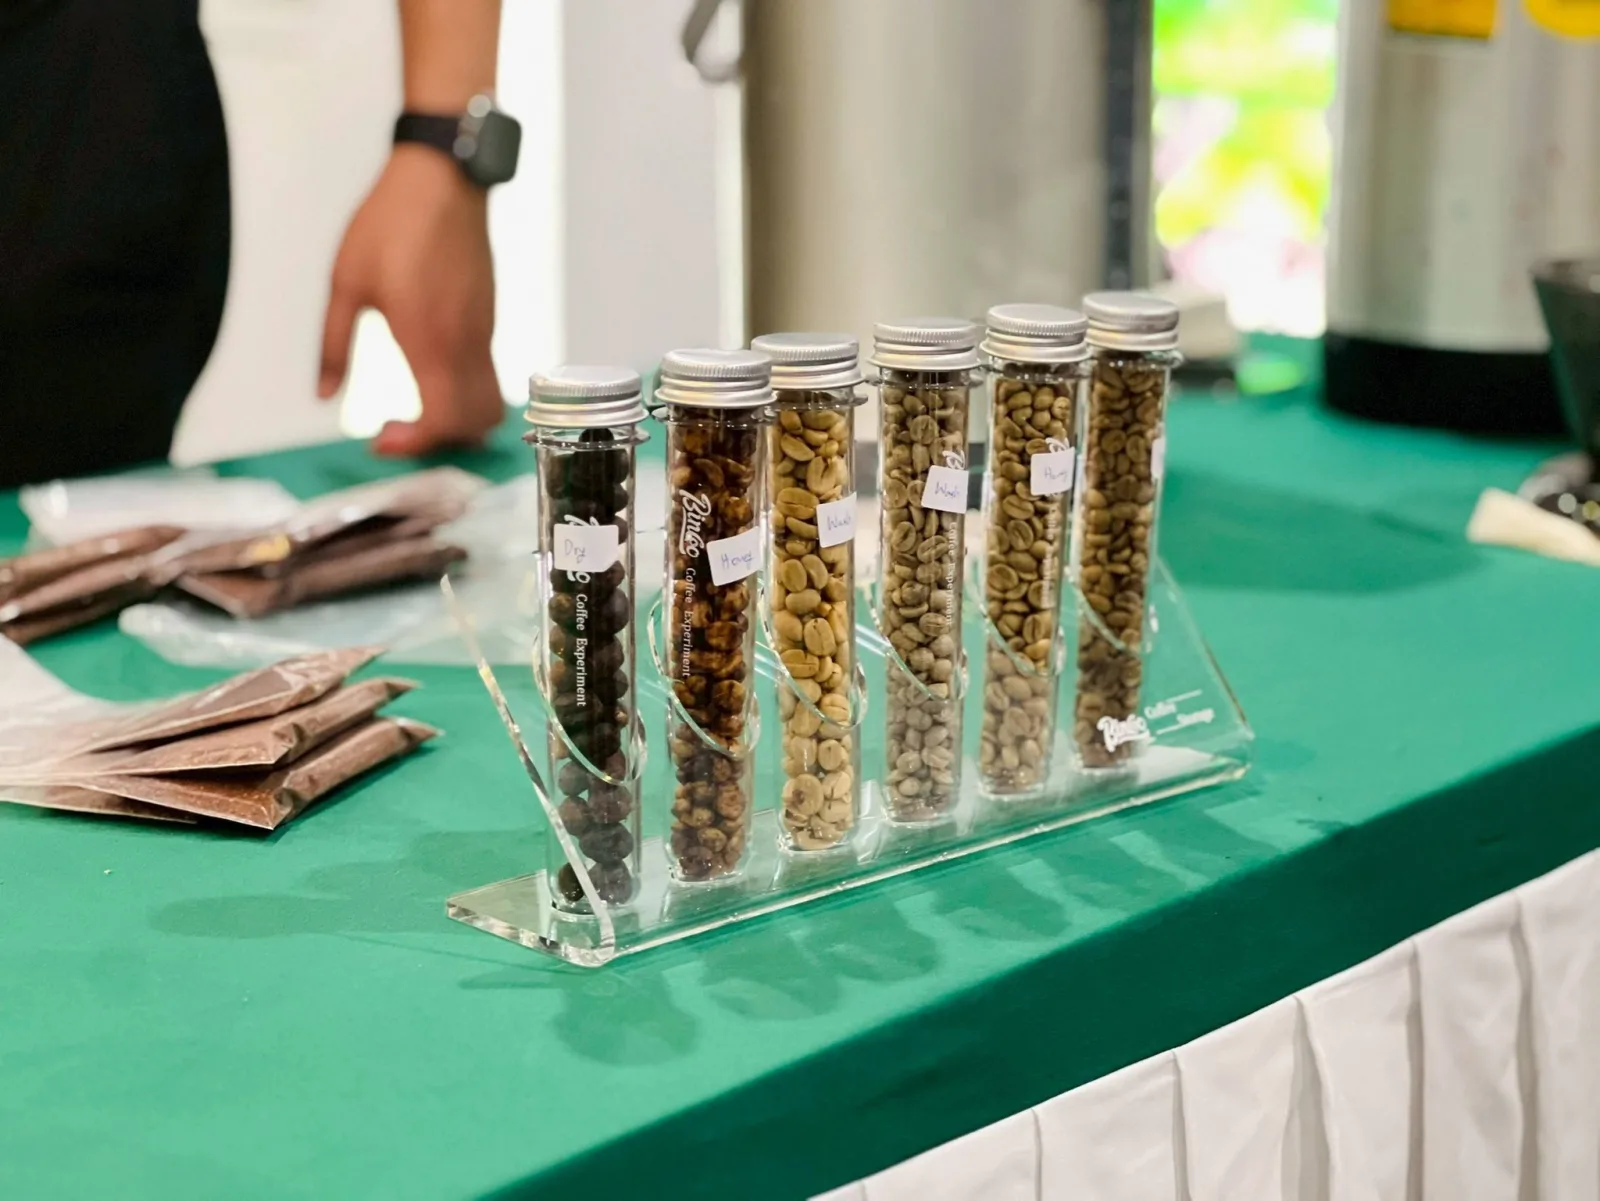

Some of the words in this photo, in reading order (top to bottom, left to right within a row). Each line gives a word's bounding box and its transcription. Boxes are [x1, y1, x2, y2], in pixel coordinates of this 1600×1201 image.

[684, 567, 697, 604] Coffee
[576, 593, 588, 631] Coffee
[680, 611, 694, 677] Experiment
[573, 638, 588, 707] Experiment
